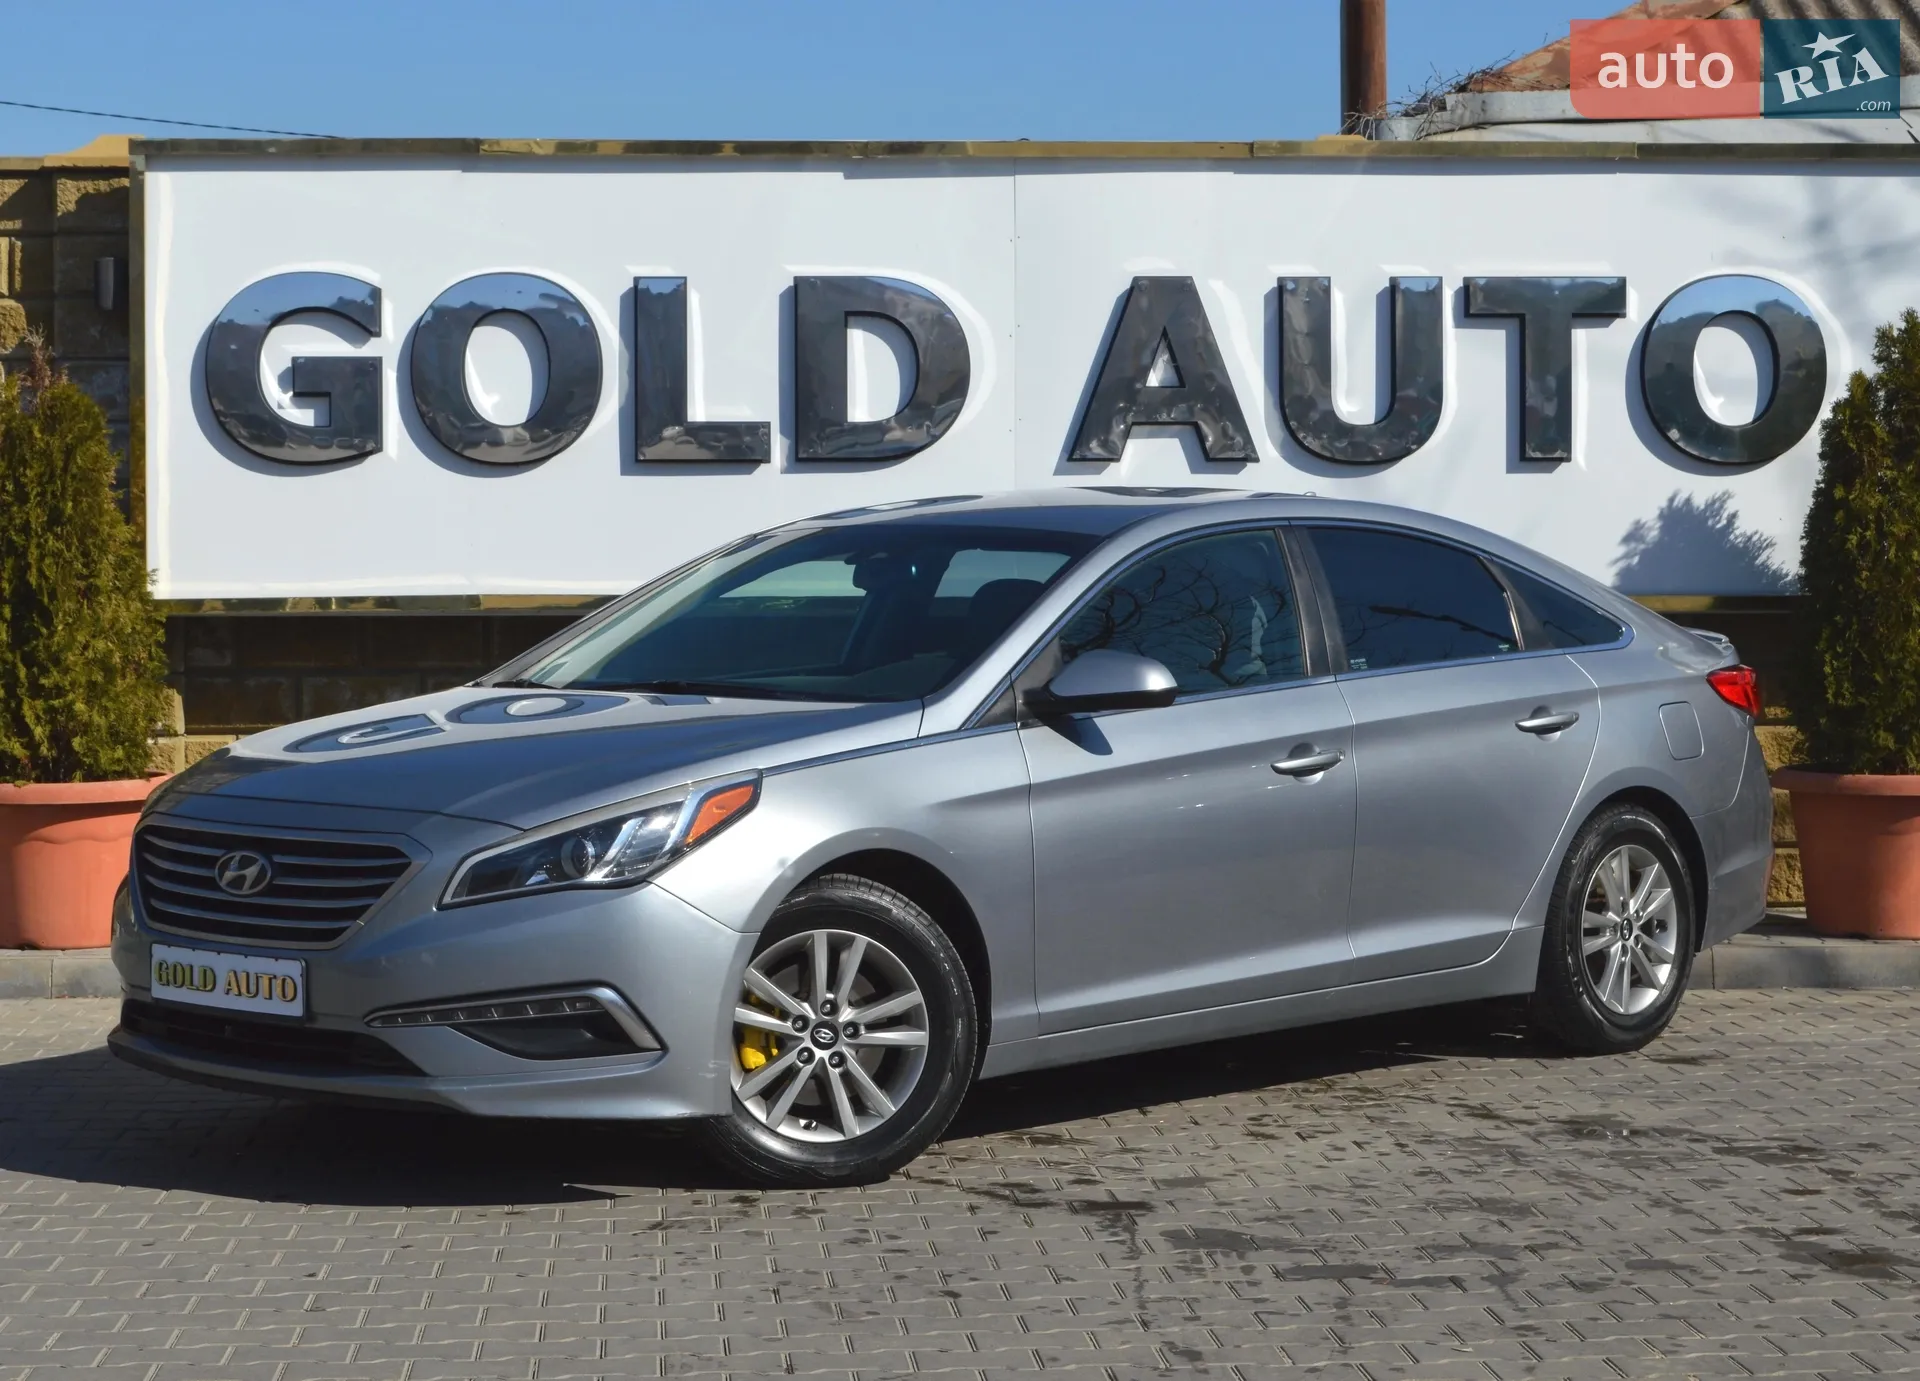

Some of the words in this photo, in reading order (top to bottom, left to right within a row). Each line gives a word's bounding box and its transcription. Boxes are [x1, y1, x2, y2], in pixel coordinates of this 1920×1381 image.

[204, 270, 971, 465] GOLD
[1066, 274, 1828, 465] AUTO
[155, 959, 216, 992] GOLD
[224, 969, 297, 1002] AUTO
